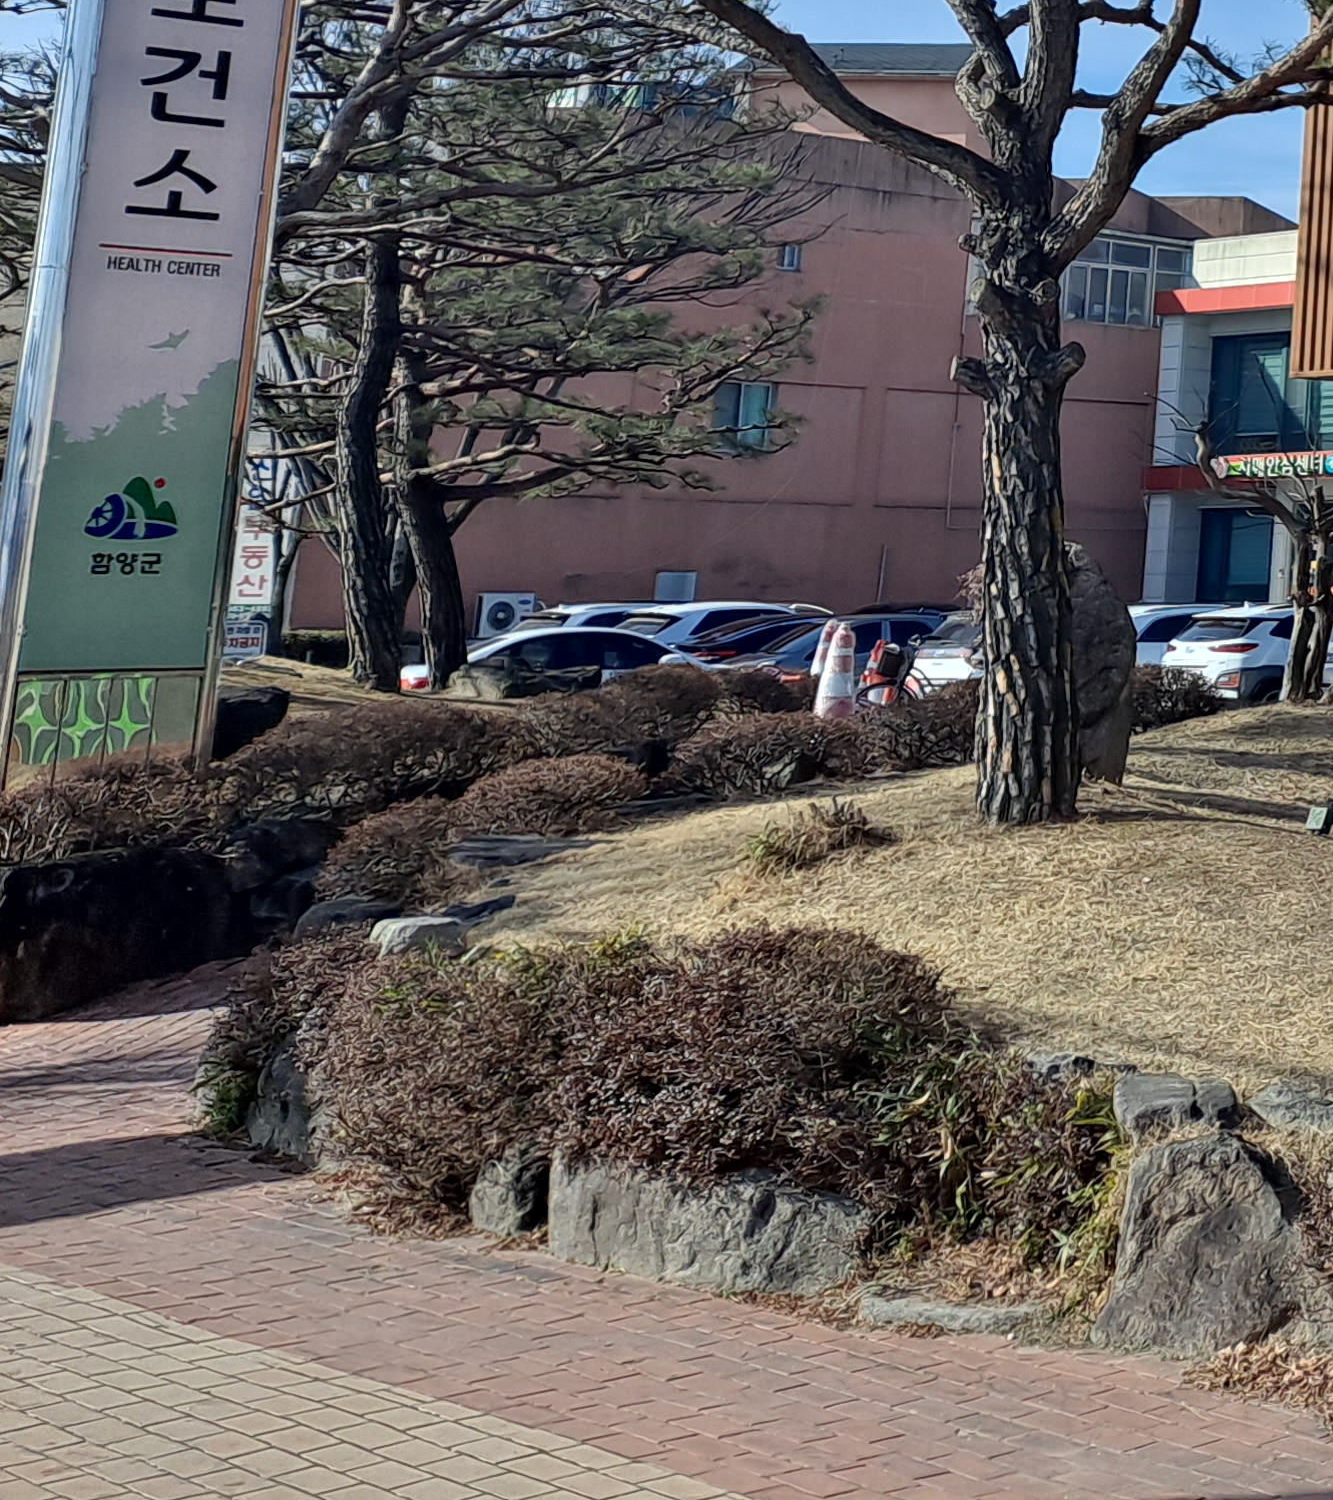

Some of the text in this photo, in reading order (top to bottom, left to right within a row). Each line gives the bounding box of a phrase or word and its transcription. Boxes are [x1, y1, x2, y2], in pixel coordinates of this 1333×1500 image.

[107, 255, 221, 278] HEALTH CENTER
[91, 552, 162, 575] 함양군
